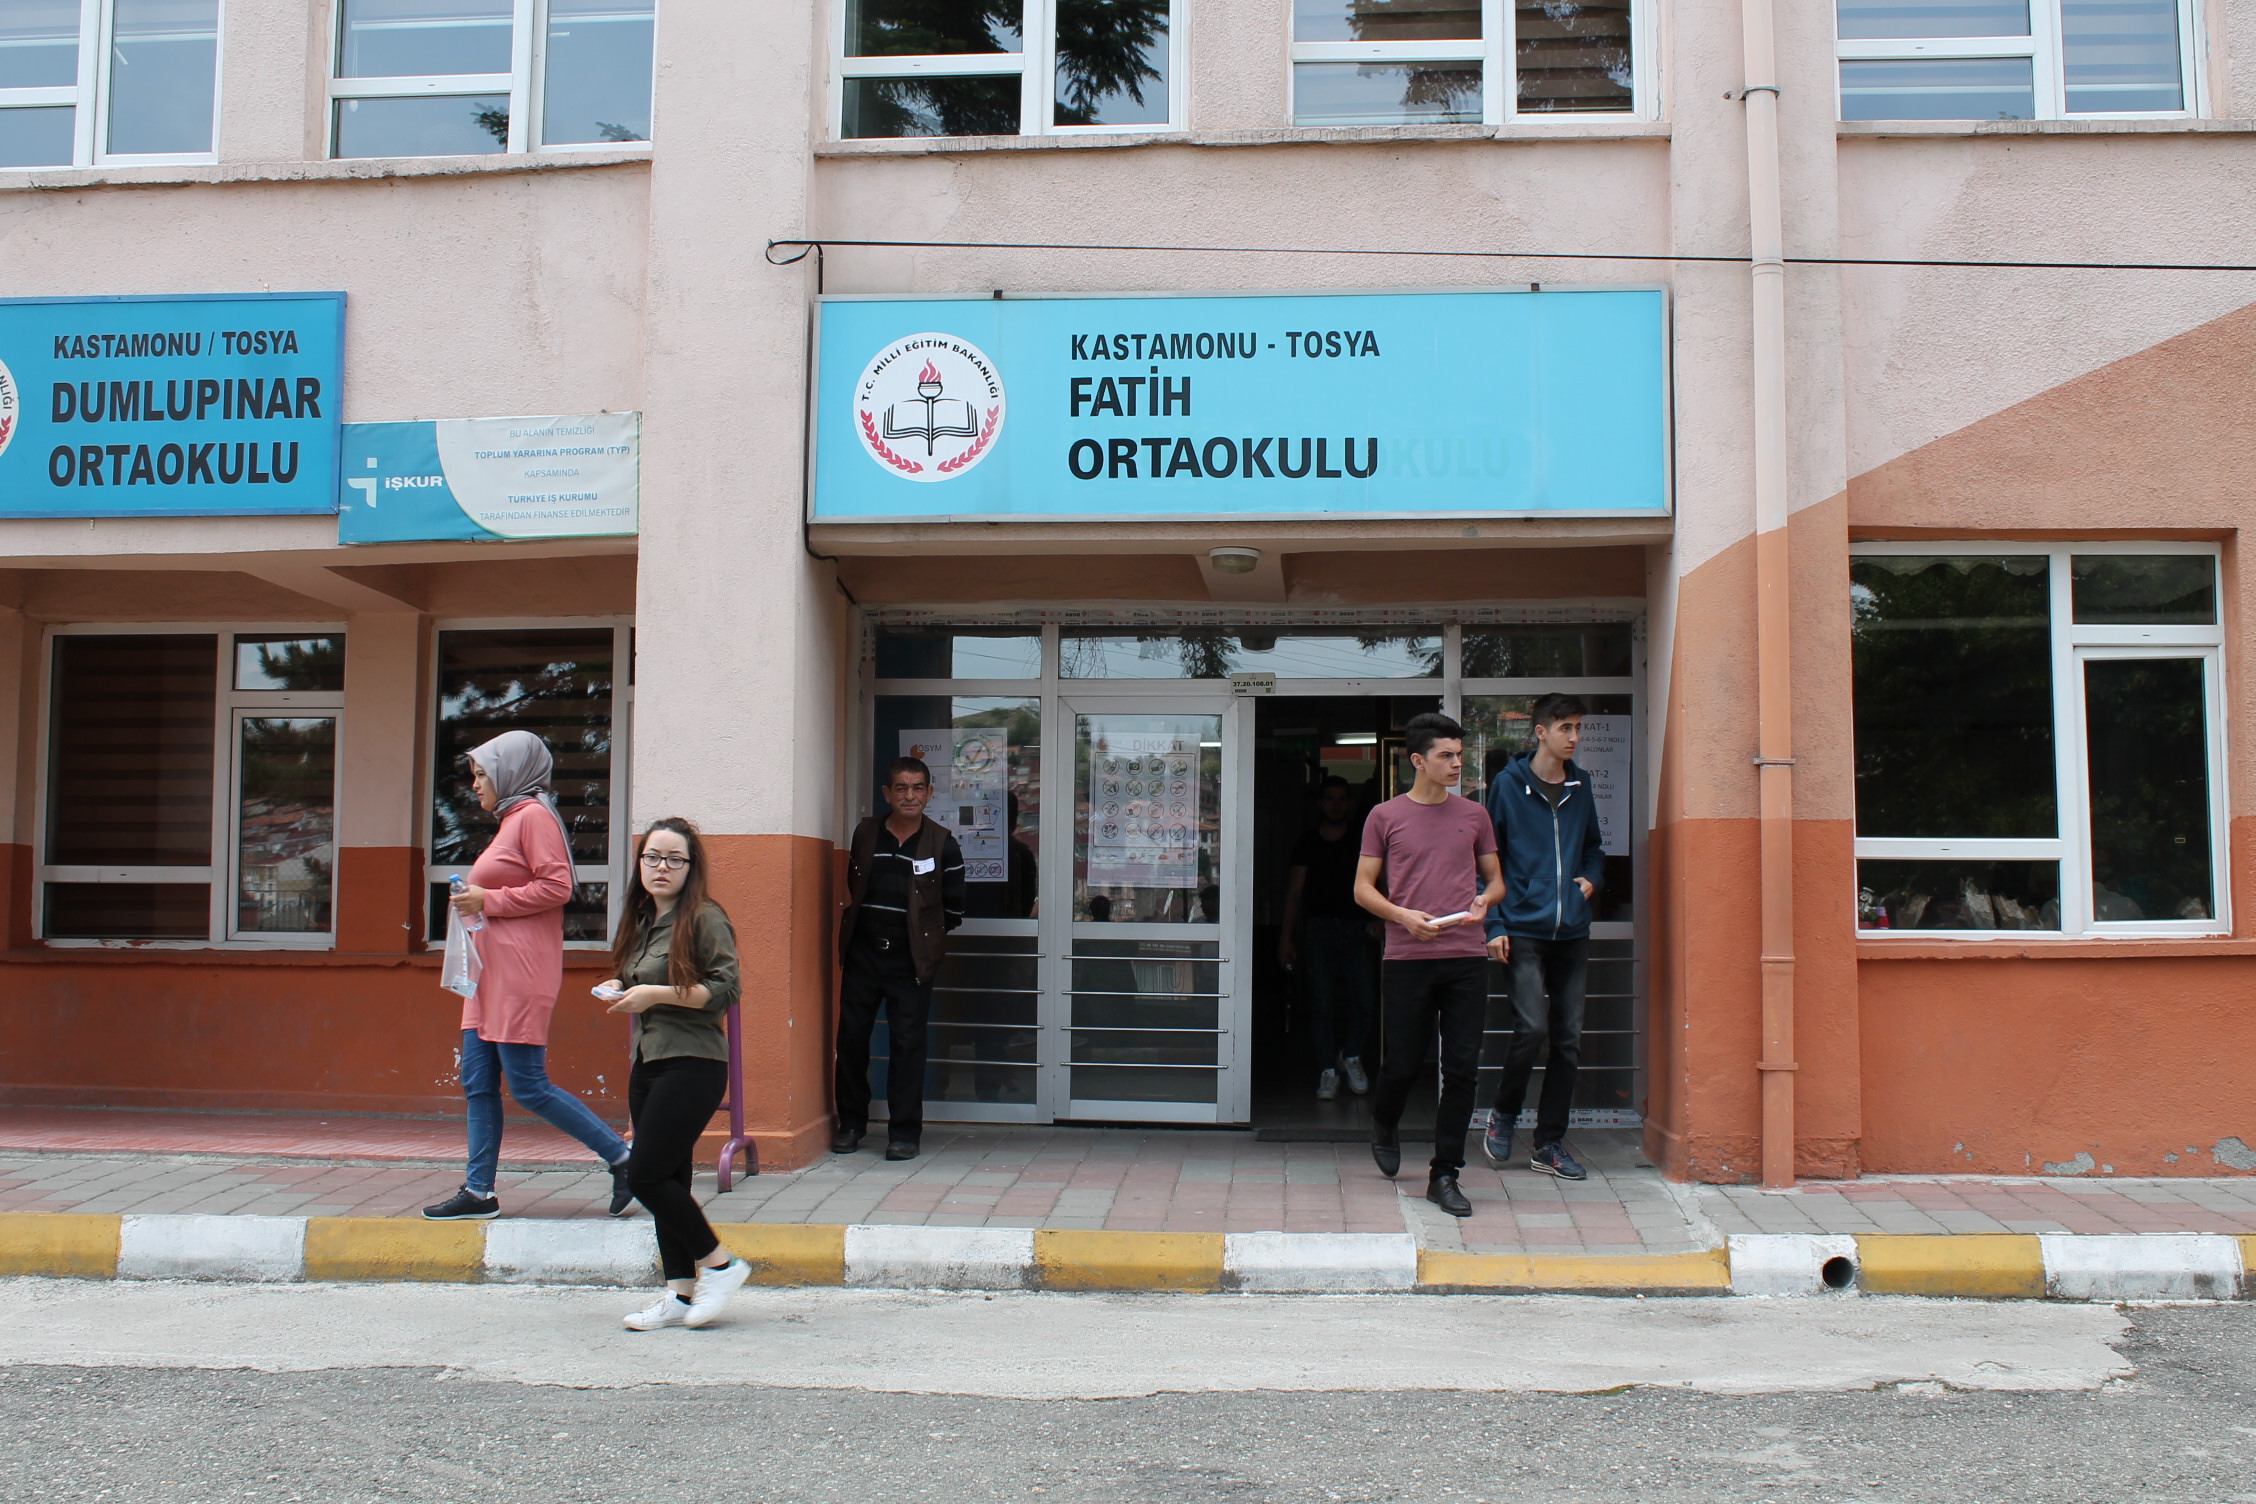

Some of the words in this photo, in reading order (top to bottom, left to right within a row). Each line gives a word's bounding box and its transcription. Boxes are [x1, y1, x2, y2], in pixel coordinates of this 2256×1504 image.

[54, 331, 202, 359] KASTAMONU
[207, 332, 215, 357] /
[222, 330, 299, 355] TOSYA
[1071, 332, 1258, 361] KASTAMONU
[1267, 342, 1277, 350] -
[1285, 330, 1381, 358] TOSYA
[861, 379, 877, 402] T.C.
[873, 347, 902, 376] MİLLİ
[905, 338, 948, 353] EĞİTİM
[951, 344, 1000, 399] BAKANLIĞI
[1070, 365, 1191, 418] FATİH
[52, 377, 322, 424] DUMLUPINAR
[509, 429, 521, 438] BU
[523, 427, 554, 437] ALANIN
[474, 448, 511, 459] TOPLUM
[513, 447, 558, 458] YARARINA
[560, 446, 604, 456] PROGRAM
[607, 445, 630, 455] (TYP)
[1068, 436, 1379, 480] ORTAOKULU
[49, 441, 299, 487] ORTAOKULU
[524, 468, 579, 478] KAPSAMINDA
[385, 475, 443, 491] İŞKUR
[508, 493, 546, 504] TÜRKİYE
[548, 492, 557, 504] İŞ
[559, 492, 598, 502] KURUMU
[479, 510, 532, 521] TARAFINDAN
[534, 509, 569, 520] FİNANSE
[571, 507, 631, 518] EDİLMEKTEDİR
[1584, 722, 1610, 732] KAT-1
[1132, 738, 1185, 752] DİKKAT
[1587, 770, 1609, 779] AT-2
